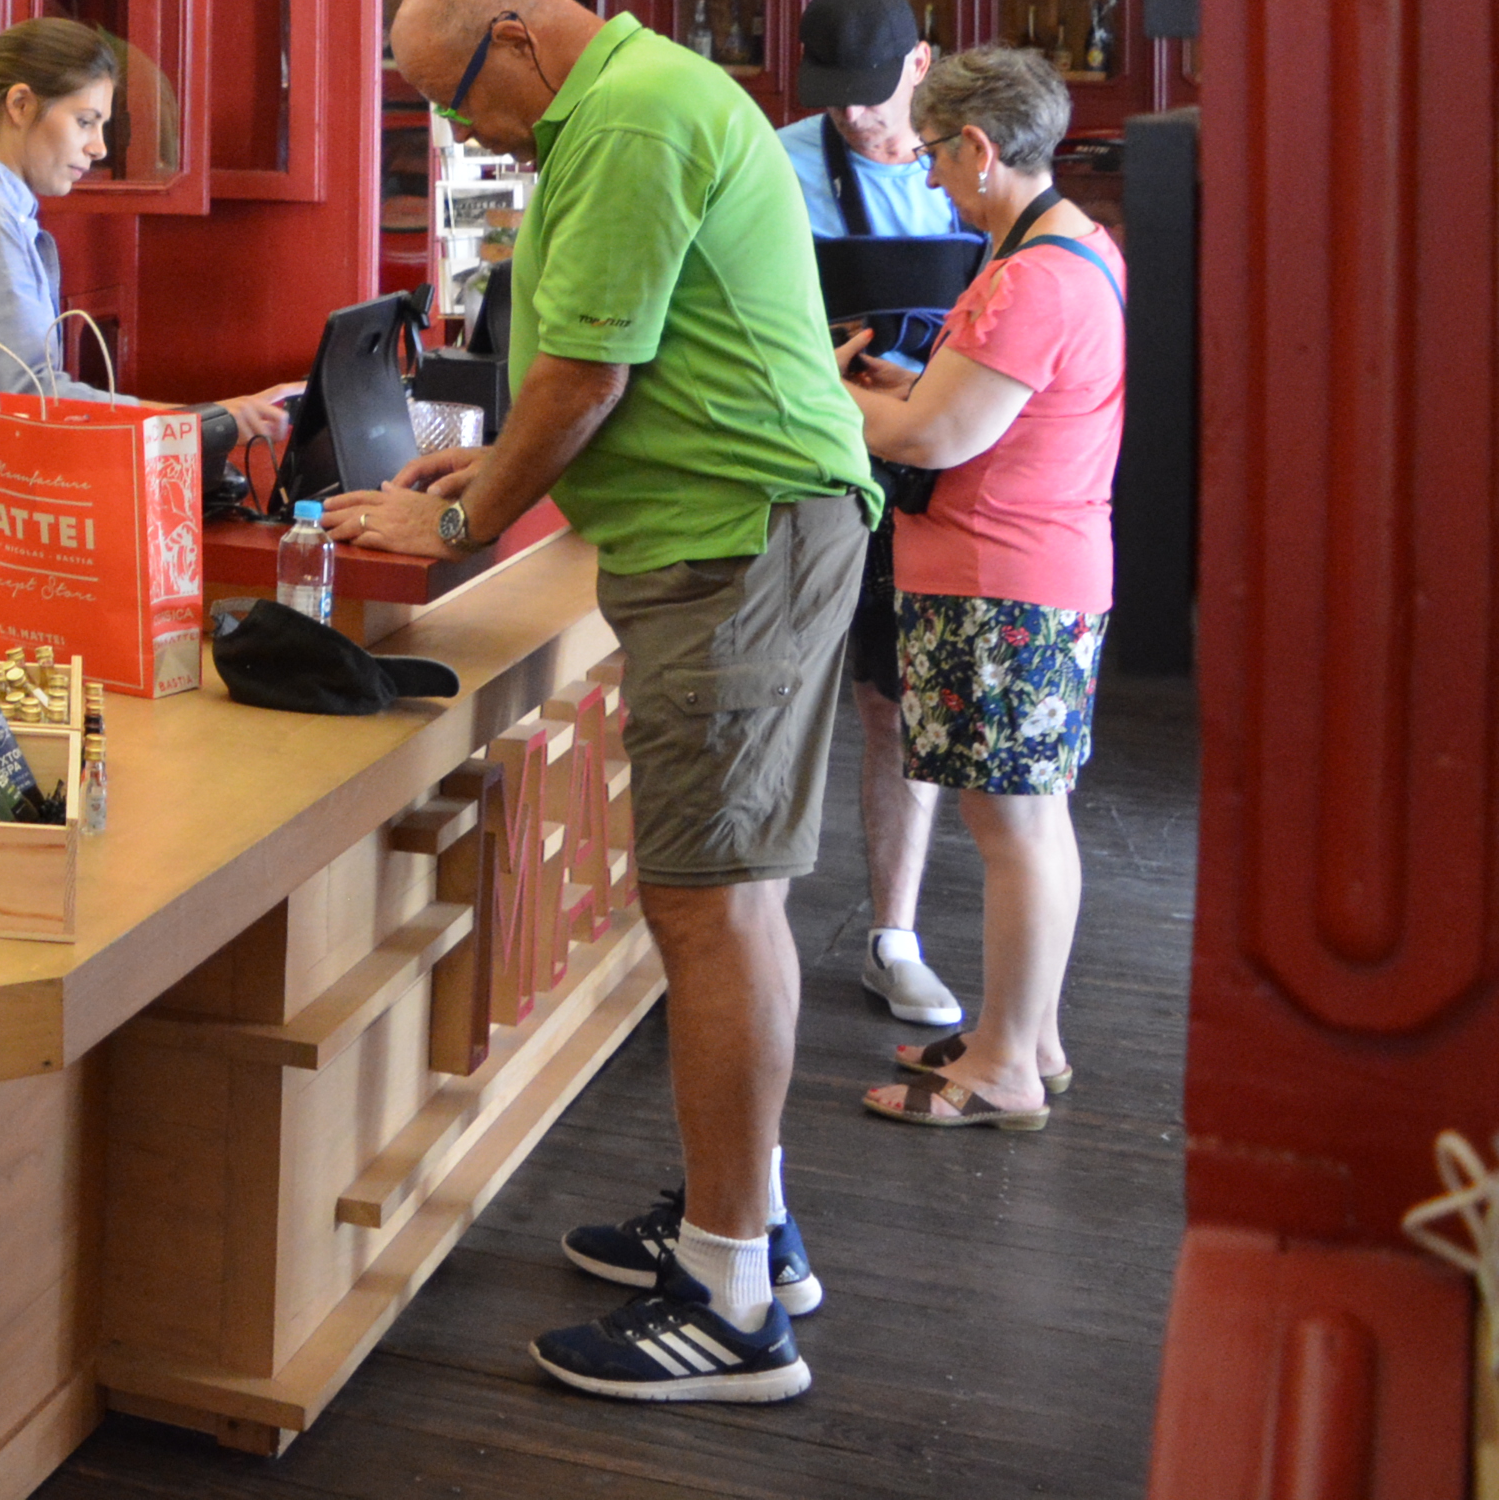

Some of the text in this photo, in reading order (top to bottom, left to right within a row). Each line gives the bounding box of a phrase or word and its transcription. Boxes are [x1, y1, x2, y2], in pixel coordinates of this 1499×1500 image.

[5, 544, 44, 558] NICOLAS
[56, 555, 93, 565] BASTIA
[41, 574, 96, 601] Store
[158, 675, 193, 692] BASTIA
